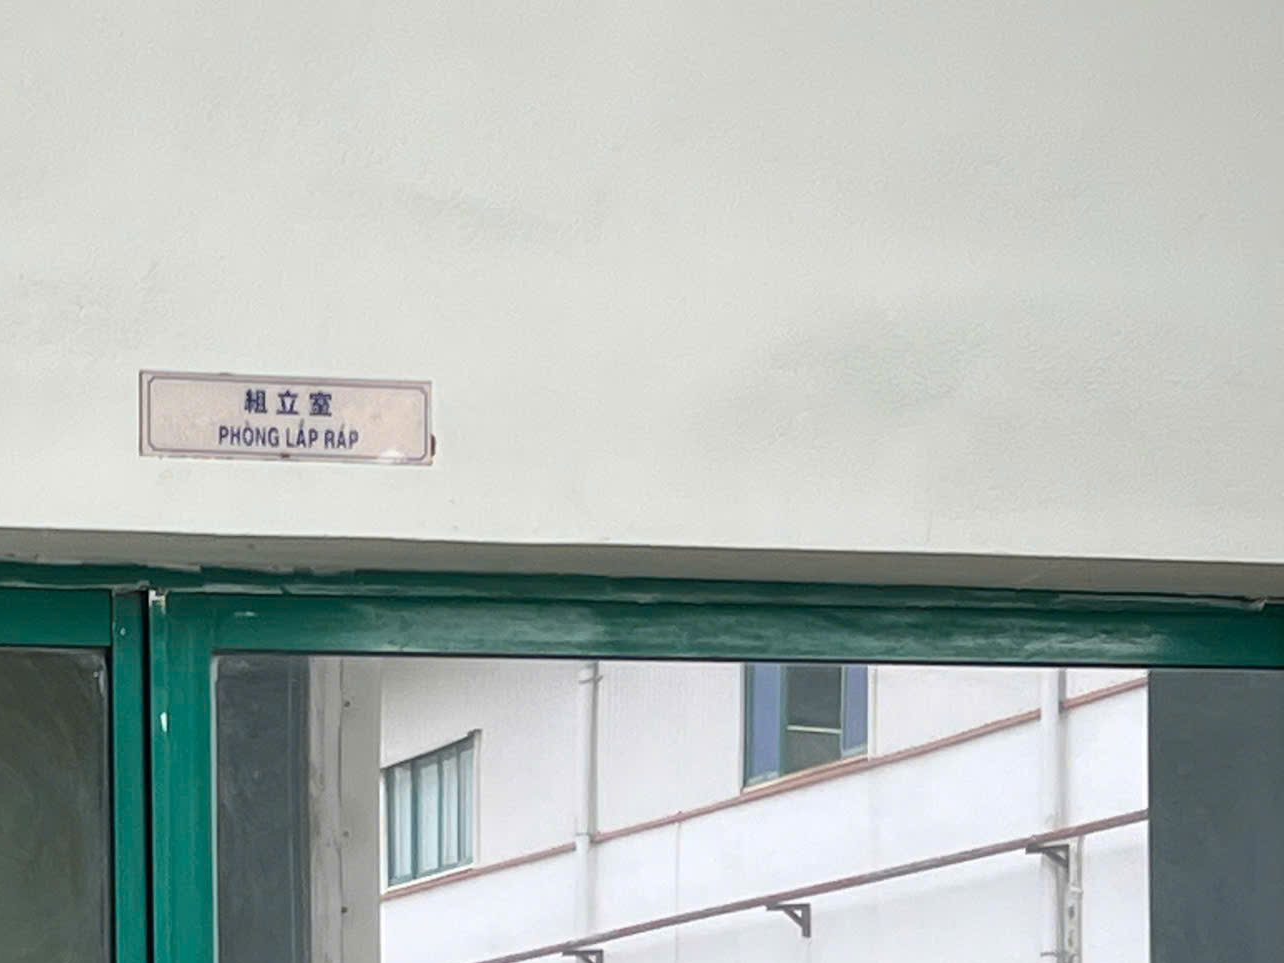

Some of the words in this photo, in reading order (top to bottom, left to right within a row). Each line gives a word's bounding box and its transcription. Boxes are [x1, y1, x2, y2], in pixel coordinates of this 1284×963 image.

[244, 388, 332, 417] 組立室
[218, 420, 280, 447] PHÒNG
[324, 422, 359, 449] RÁP
